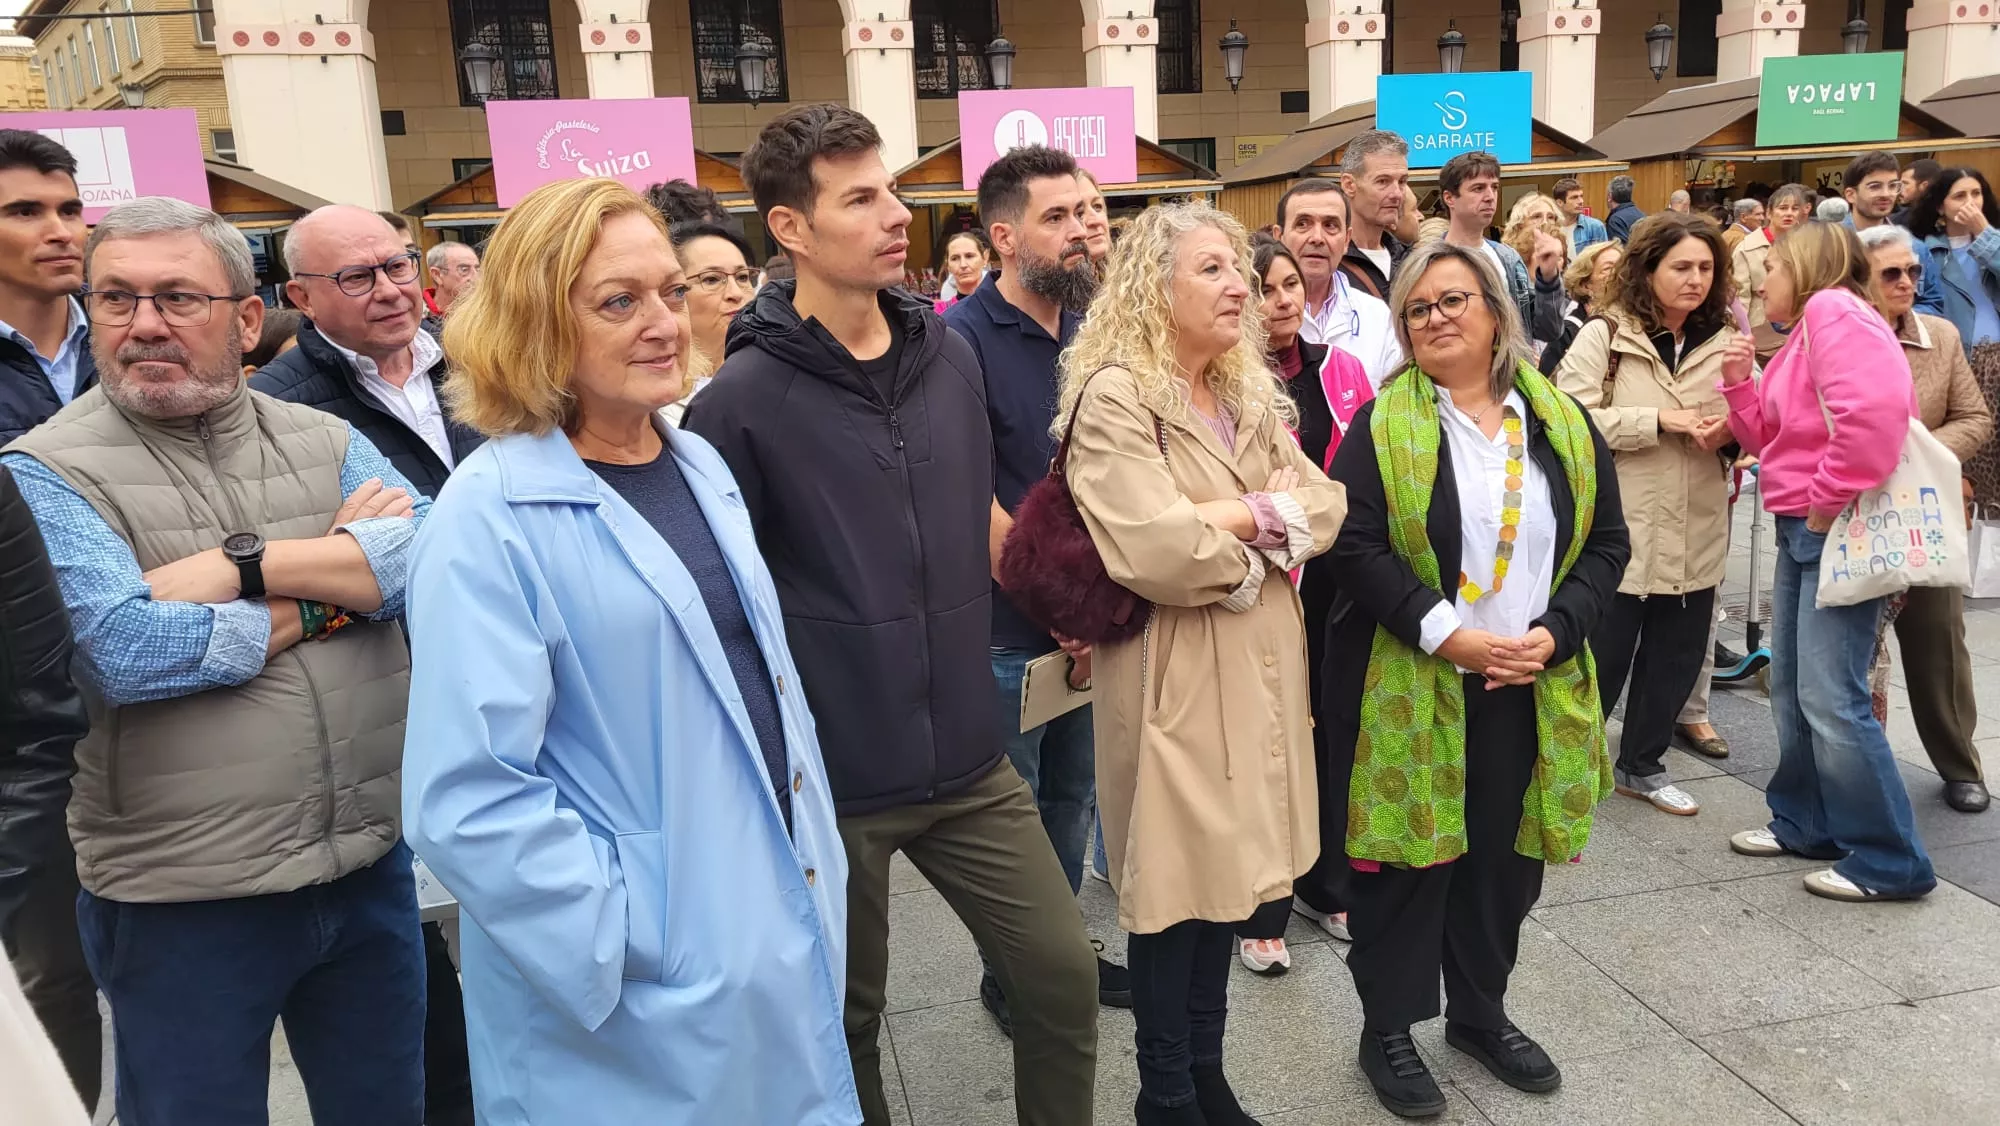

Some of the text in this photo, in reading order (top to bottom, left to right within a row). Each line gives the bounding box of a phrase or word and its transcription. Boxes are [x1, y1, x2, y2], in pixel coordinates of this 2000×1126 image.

[1787, 82, 1875, 104] LAPACA
[1053, 116, 1105, 158] ASCASO
[1414, 132, 1496, 149] SARRATE
[560, 138, 584, 162] La
[577, 150, 652, 178] Suiza
[81, 188, 133, 202] OSANA
